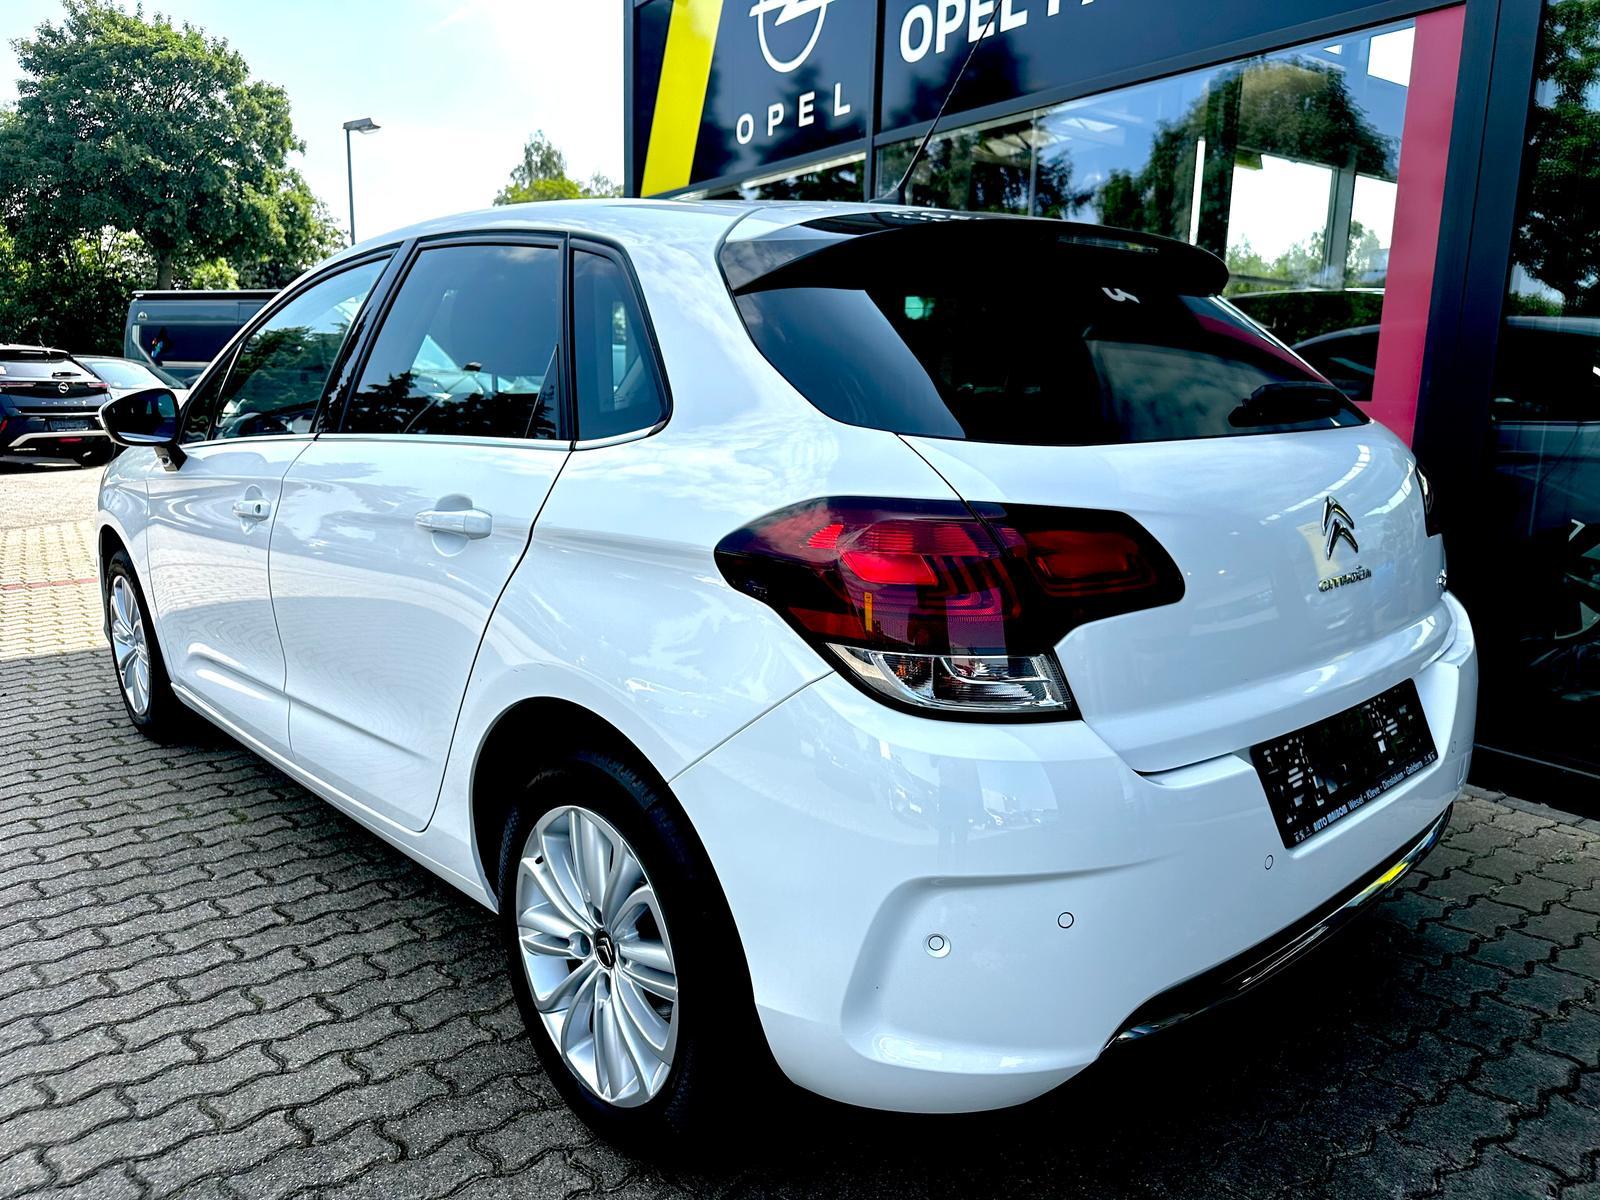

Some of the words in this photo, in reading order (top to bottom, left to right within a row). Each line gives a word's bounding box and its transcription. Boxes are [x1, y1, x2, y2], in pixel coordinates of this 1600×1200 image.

[899, 0, 1028, 63] OPEL
[735, 82, 851, 145] OPEL
[1347, 794, 1365, 810] Wesel
[1365, 787, 1381, 800] Kleve
